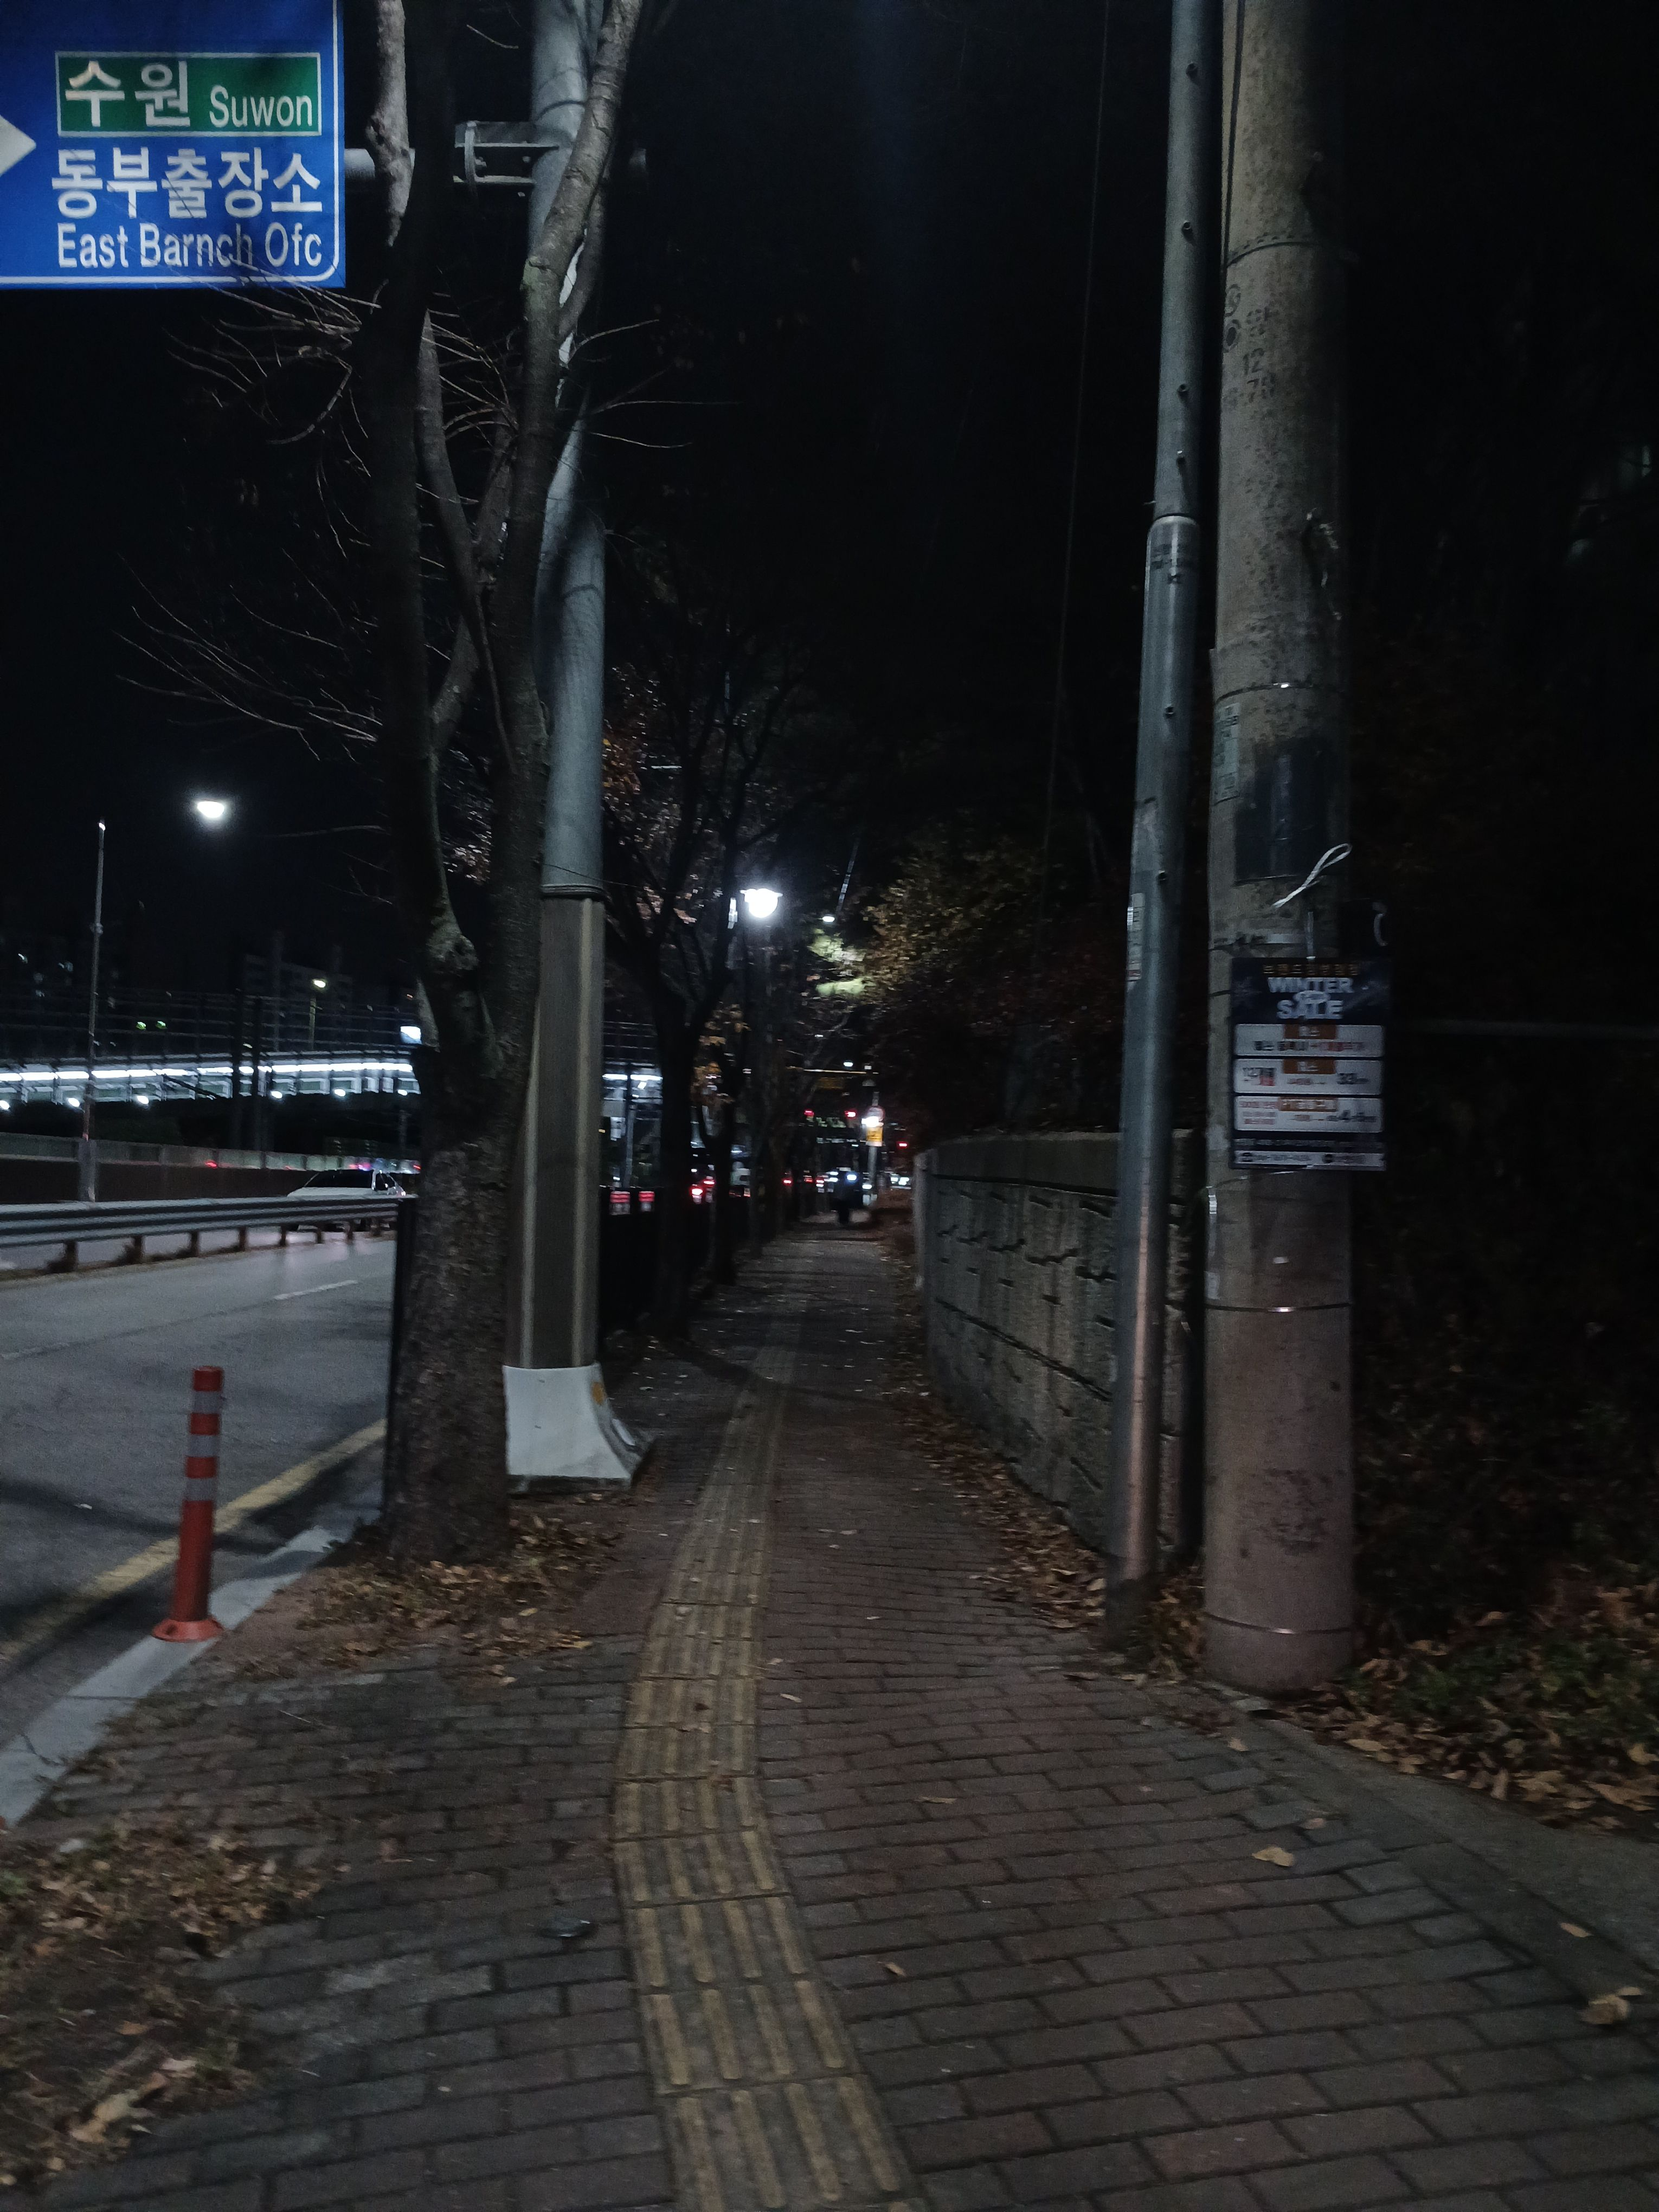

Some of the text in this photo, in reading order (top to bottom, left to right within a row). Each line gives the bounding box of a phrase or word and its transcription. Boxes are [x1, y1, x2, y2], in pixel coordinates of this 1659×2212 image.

[65, 60, 313, 128] 수원 Suwon
[52, 146, 323, 220] 동부출장소
[57, 222, 322, 268] East Barnch Ofc
[1267, 977, 1354, 993] WINTER
[1276, 999, 1343, 1020] SALE
